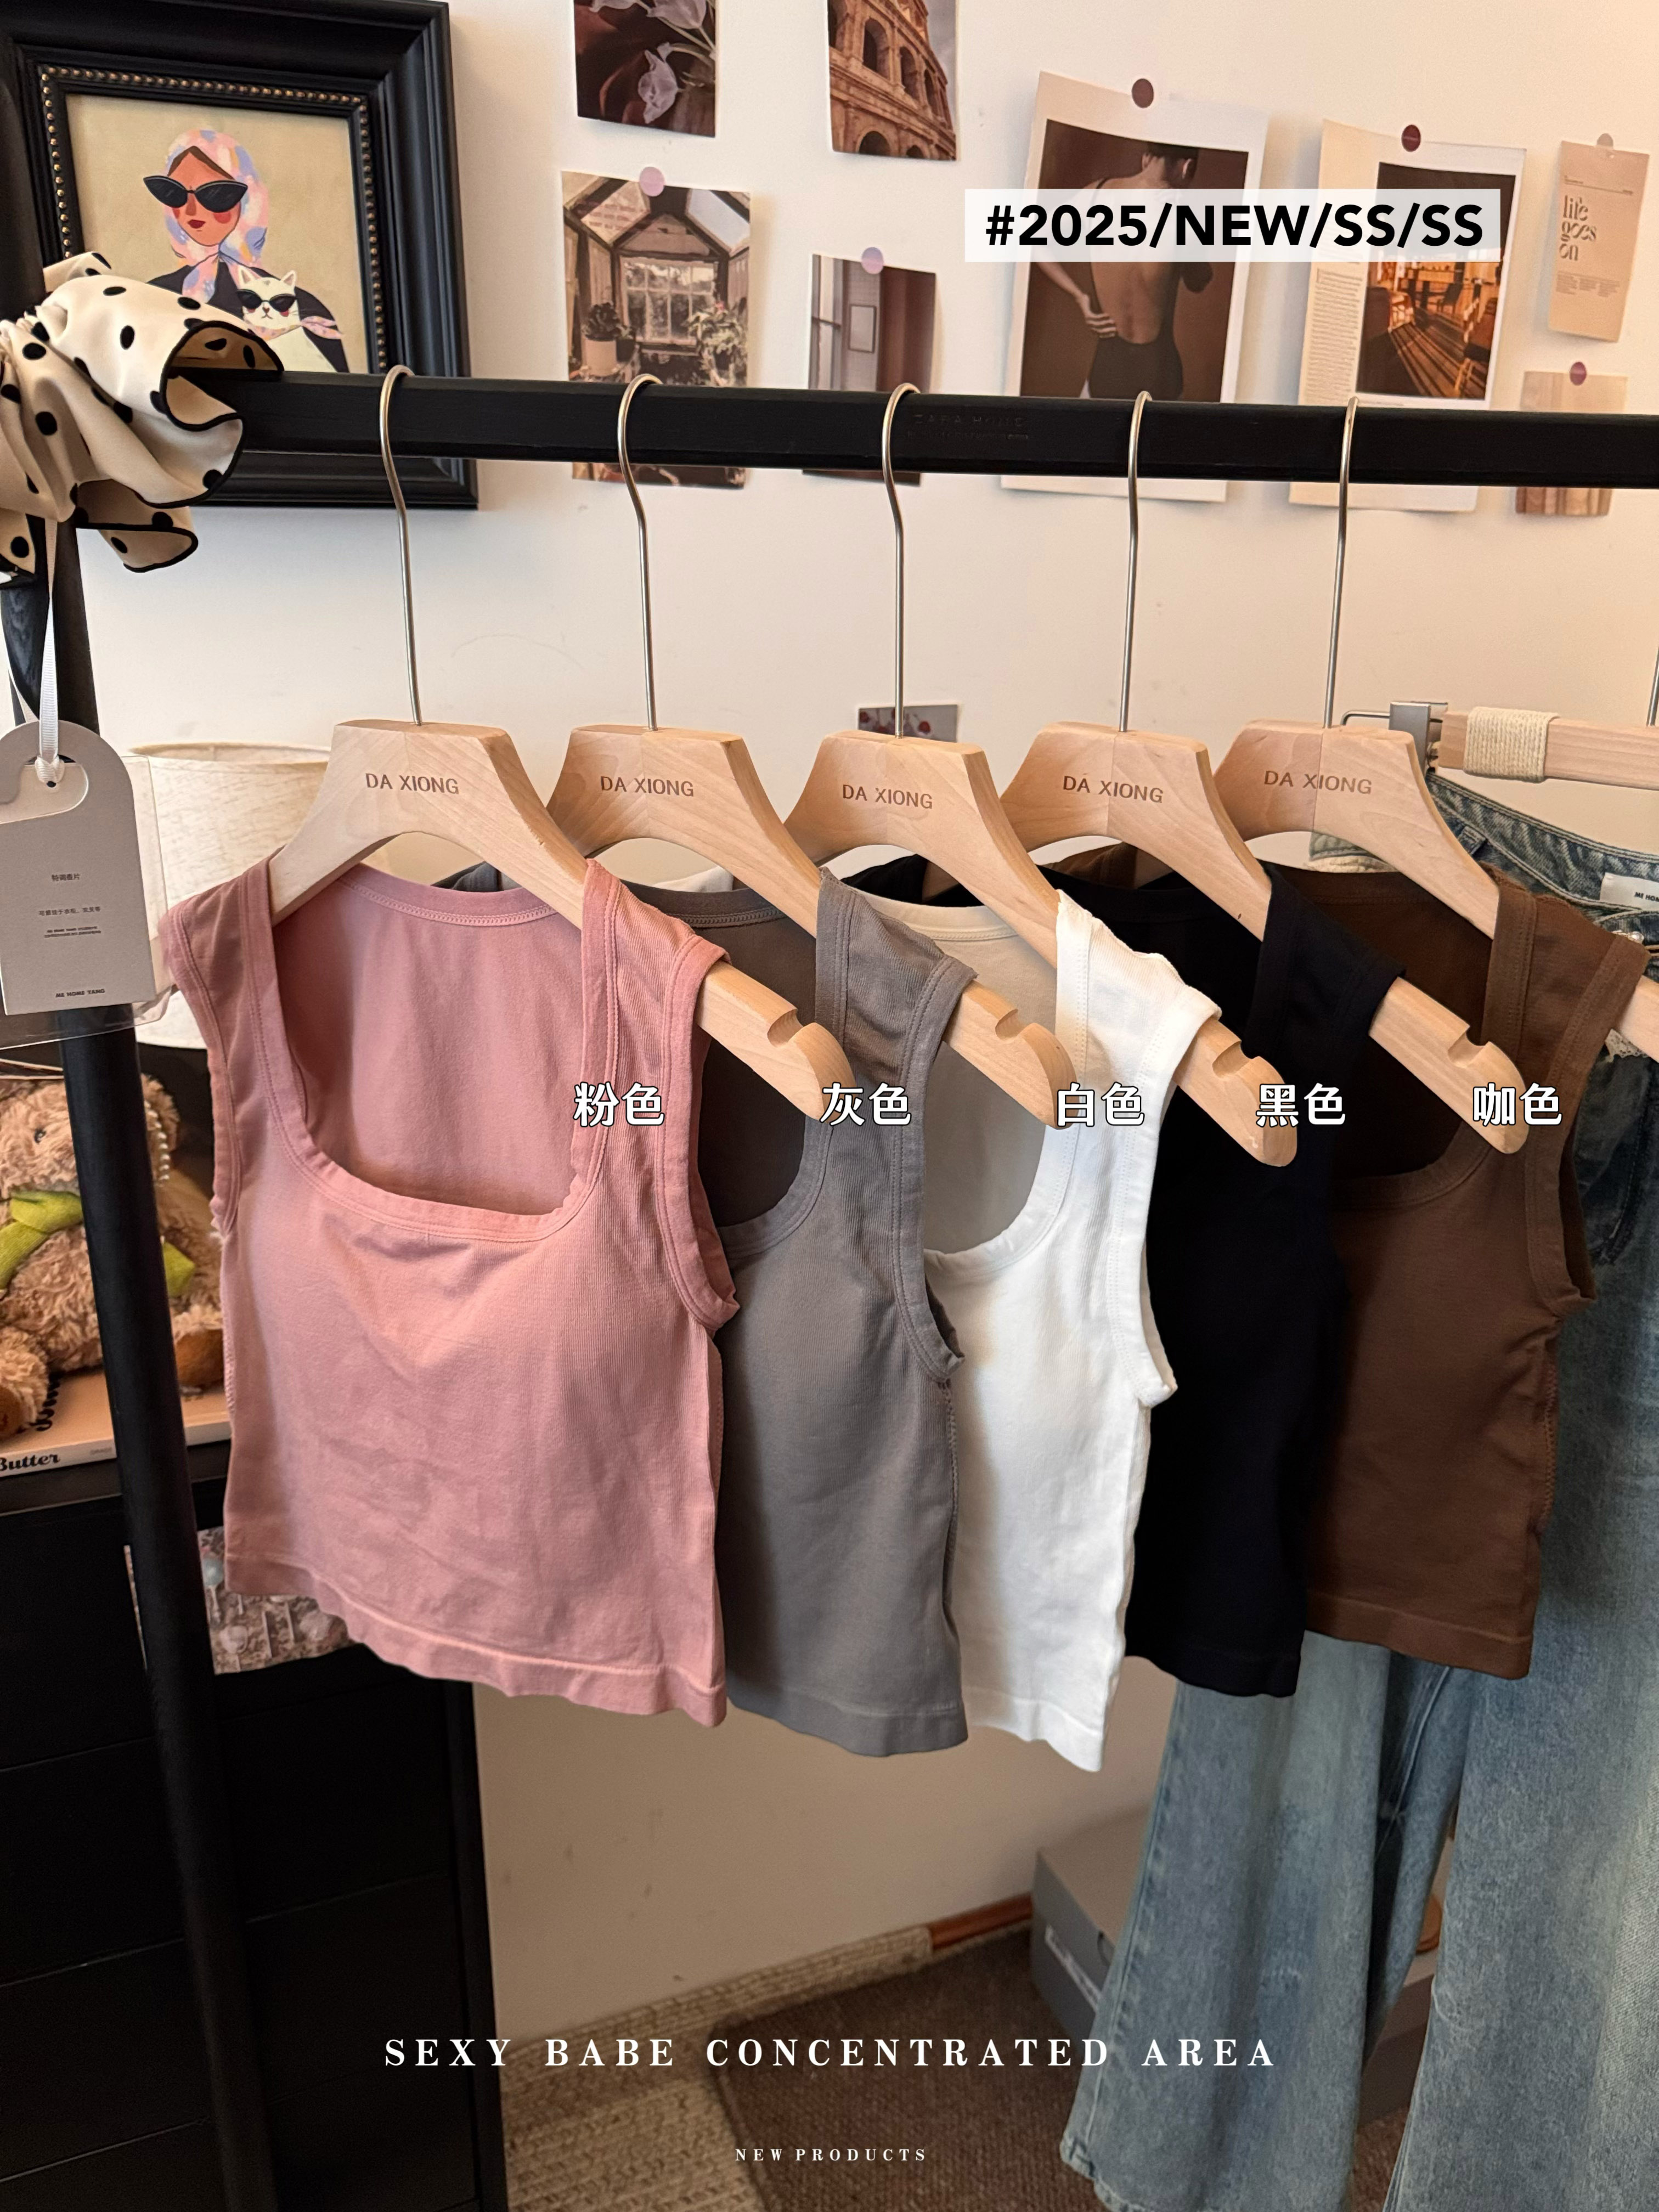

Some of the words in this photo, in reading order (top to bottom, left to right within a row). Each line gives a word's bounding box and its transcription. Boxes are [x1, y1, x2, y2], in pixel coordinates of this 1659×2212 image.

[1562, 194, 1589, 221] life
[1561, 221, 1597, 242] goes
[1559, 243, 1578, 261] on
[366, 773, 393, 789] DA
[399, 775, 459, 794] XIONG
[601, 776, 627, 792] DA
[634, 777, 694, 797] XIONG
[1063, 775, 1090, 793] DA
[1098, 780, 1164, 803] XIONG
[1264, 770, 1293, 787] DA
[1303, 774, 1372, 794] XIONG
[843, 785, 867, 801] DA
[875, 788, 933, 809] XIONG
